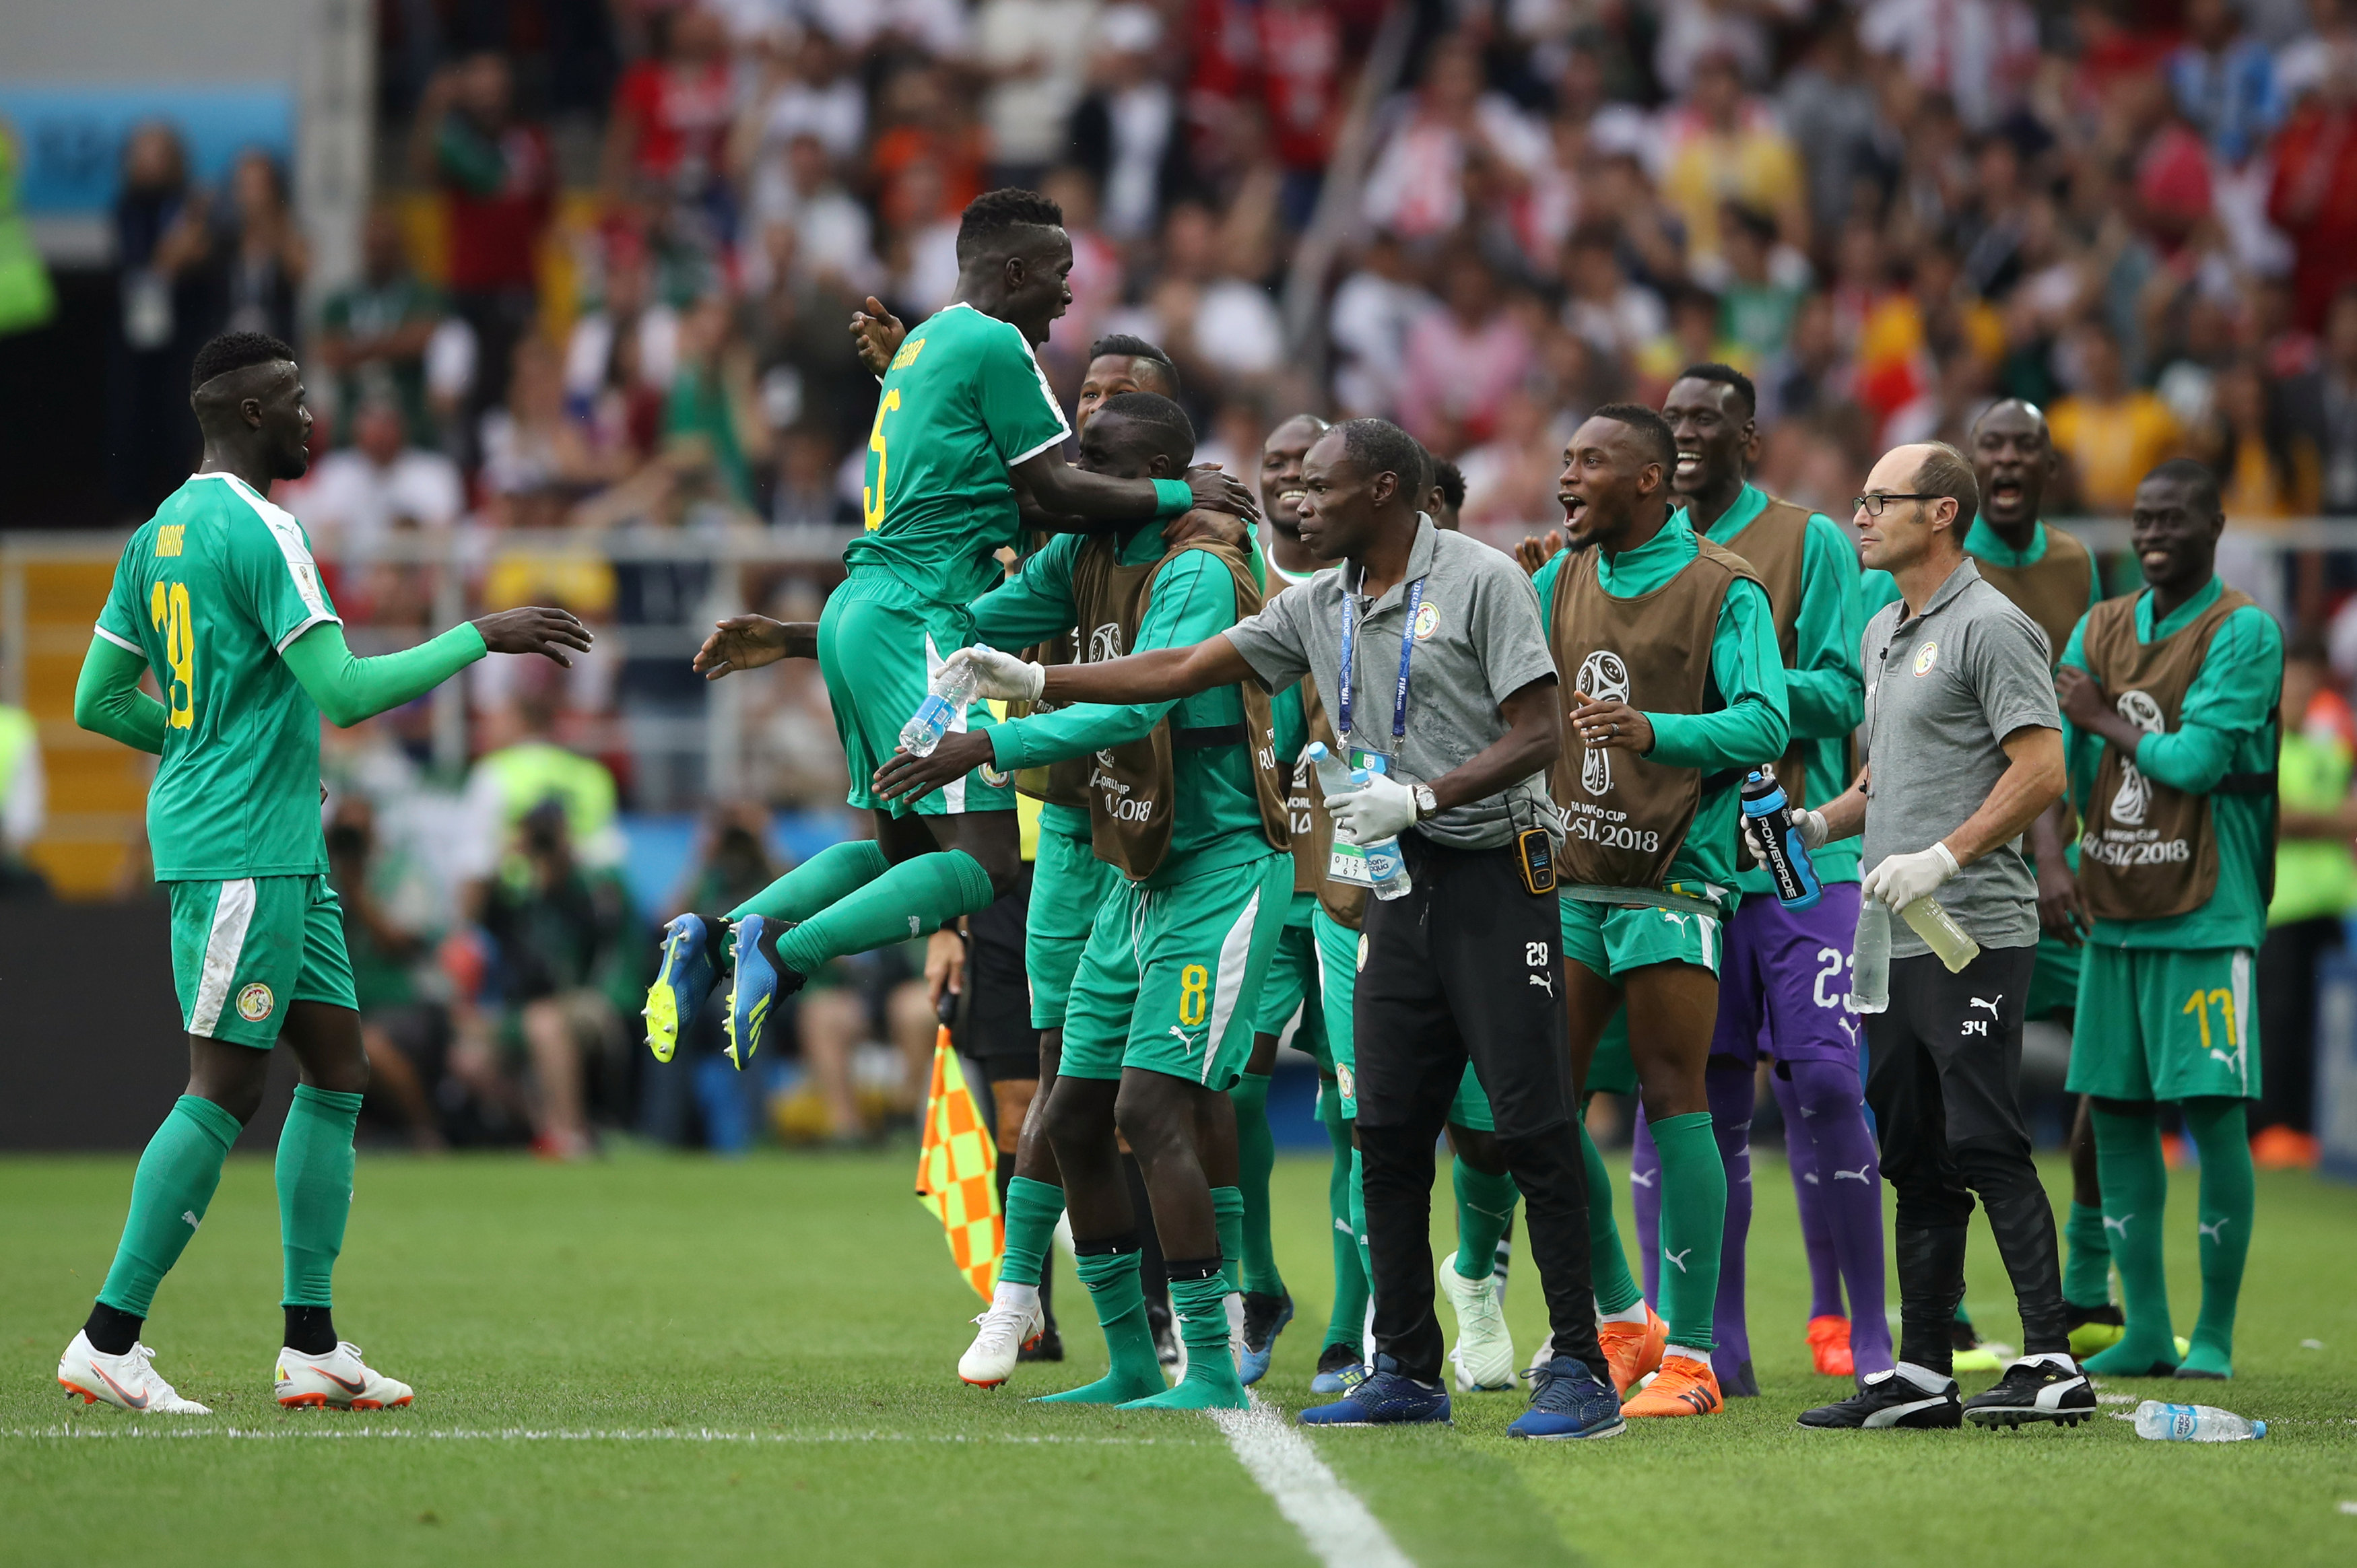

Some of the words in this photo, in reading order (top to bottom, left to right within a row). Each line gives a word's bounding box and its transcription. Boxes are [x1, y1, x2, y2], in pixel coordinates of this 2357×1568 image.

[863, 388, 900, 531] 5
[155, 524, 186, 557] NIANG
[1410, 592, 1419, 609] CUP
[1403, 610, 1416, 640] RUSSIA
[1365, 759, 1372, 768] 15
[1287, 797, 1312, 809] ORL
[1605, 810, 1627, 823] CUP
[1599, 824, 1659, 852] 2018
[1335, 855, 1340, 864] 0
[1354, 859, 1359, 868] 2
[1757, 816, 1797, 899] POWERADE
[2133, 838, 2190, 865] 2018
[1343, 867, 1348, 875] 6
[1525, 941, 1548, 967] 29
[1179, 963, 1208, 1026] 8
[1961, 1020, 1987, 1037] 34
[2183, 987, 2237, 1048] 17
